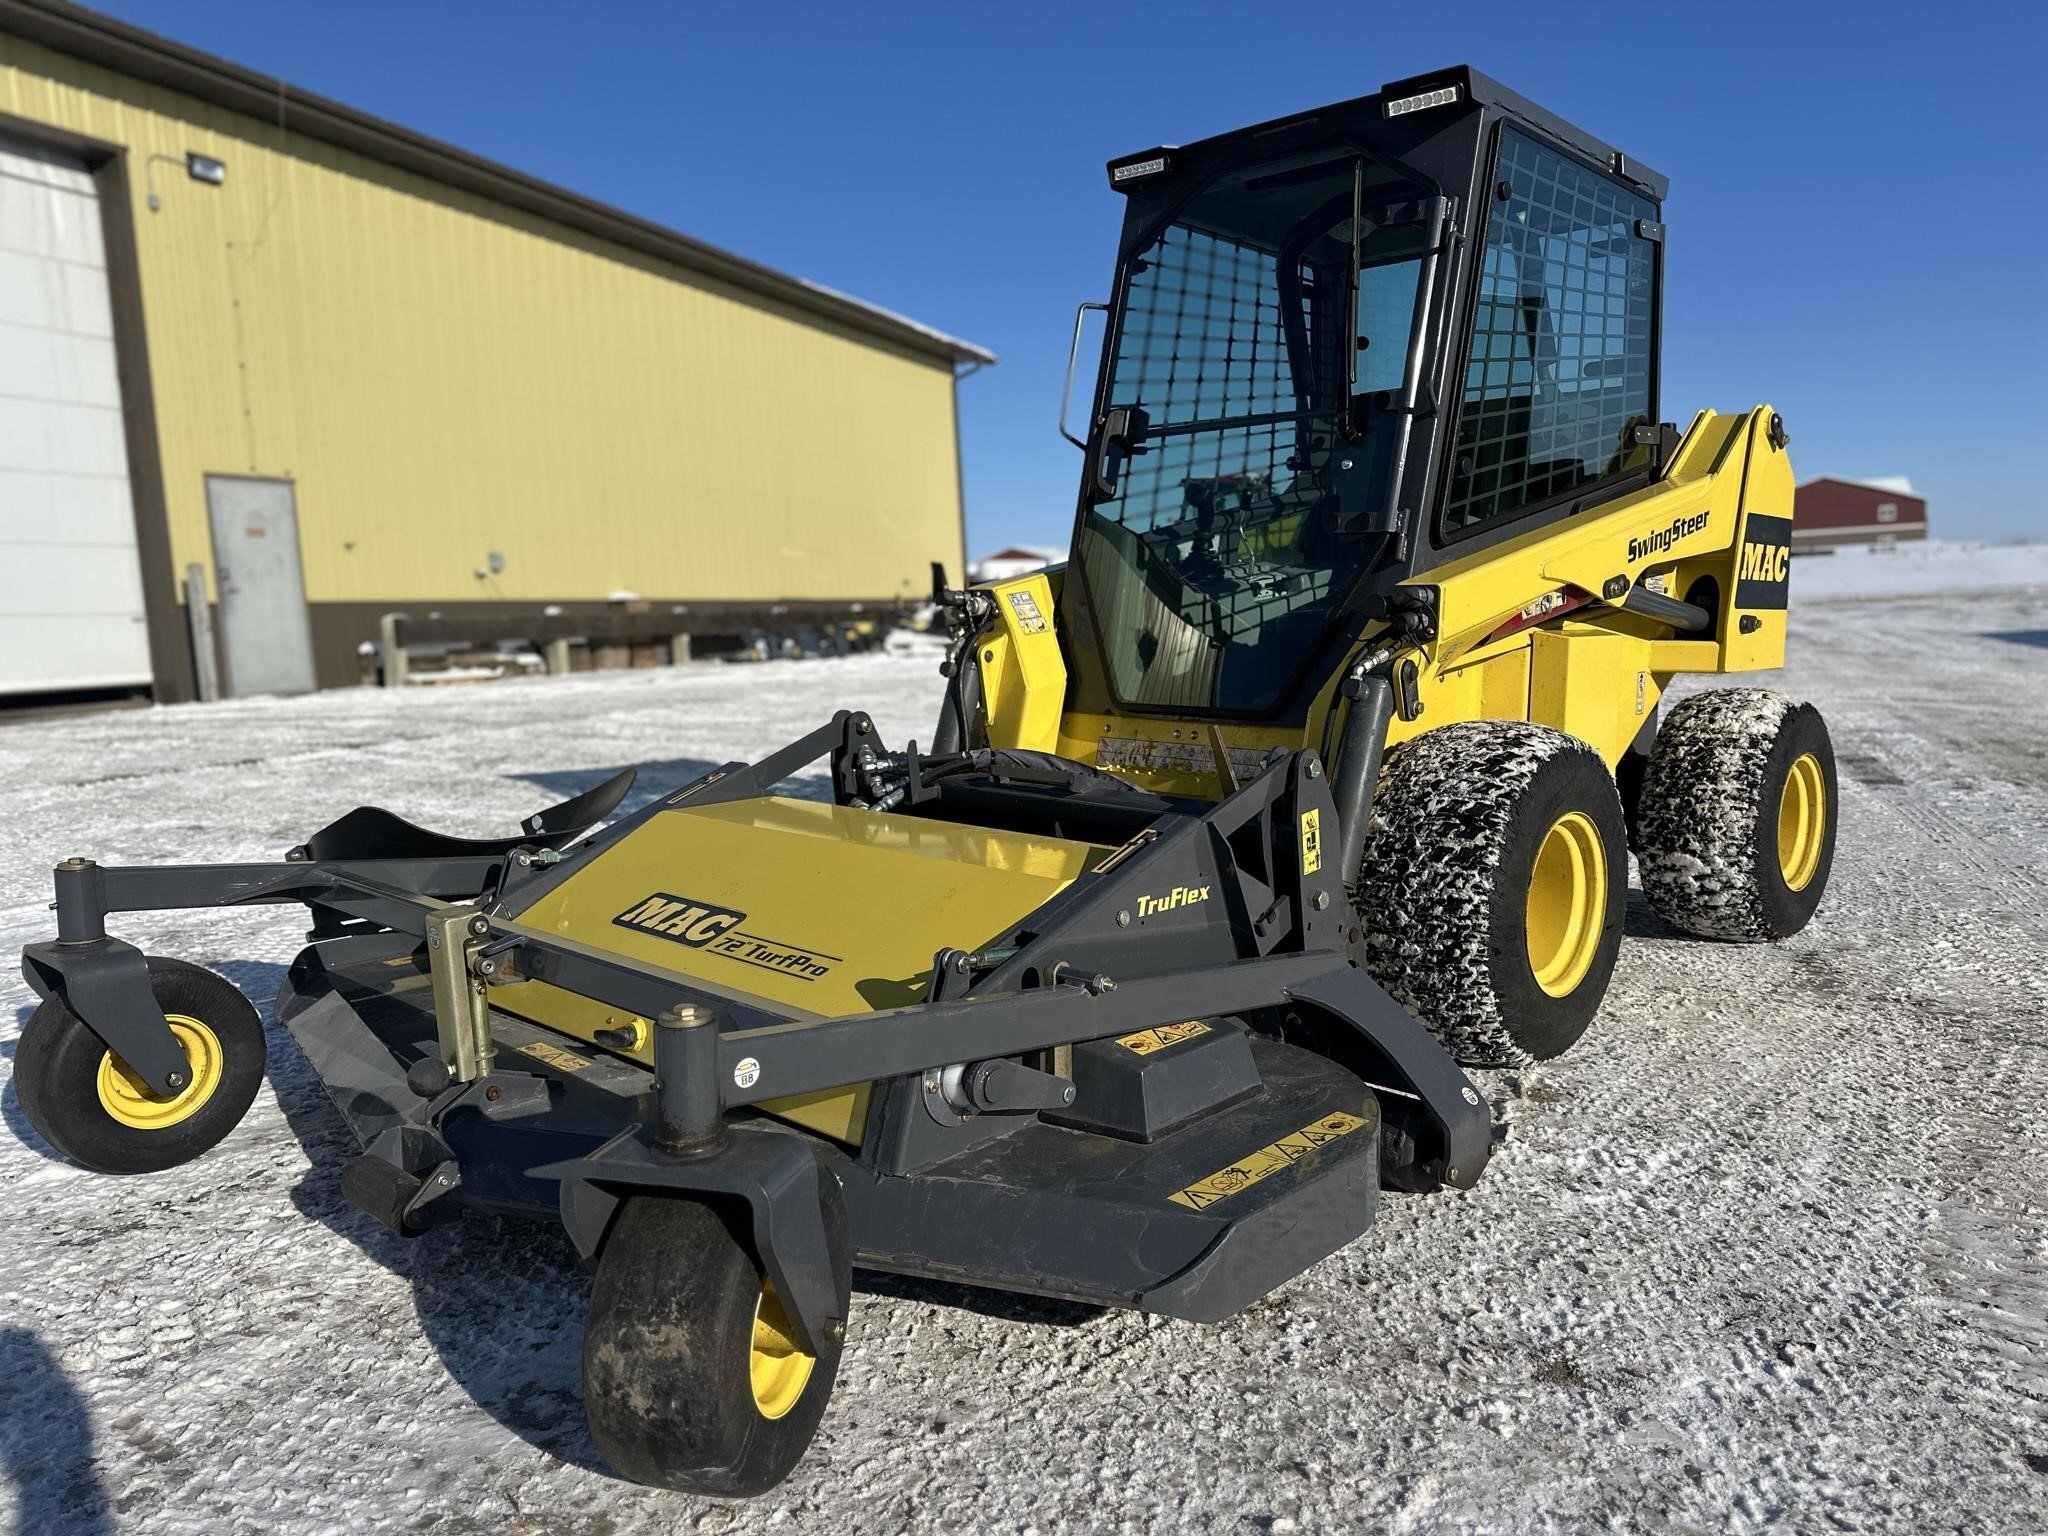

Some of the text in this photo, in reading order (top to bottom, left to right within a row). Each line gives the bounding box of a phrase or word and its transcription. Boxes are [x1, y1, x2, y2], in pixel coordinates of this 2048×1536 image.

[1628, 510, 1710, 564] SwingSteer
[1740, 542, 1790, 583] MAC
[619, 896, 740, 942] MAC
[1137, 885, 1211, 918] TruFlex
[746, 943, 830, 977] TurfPro
